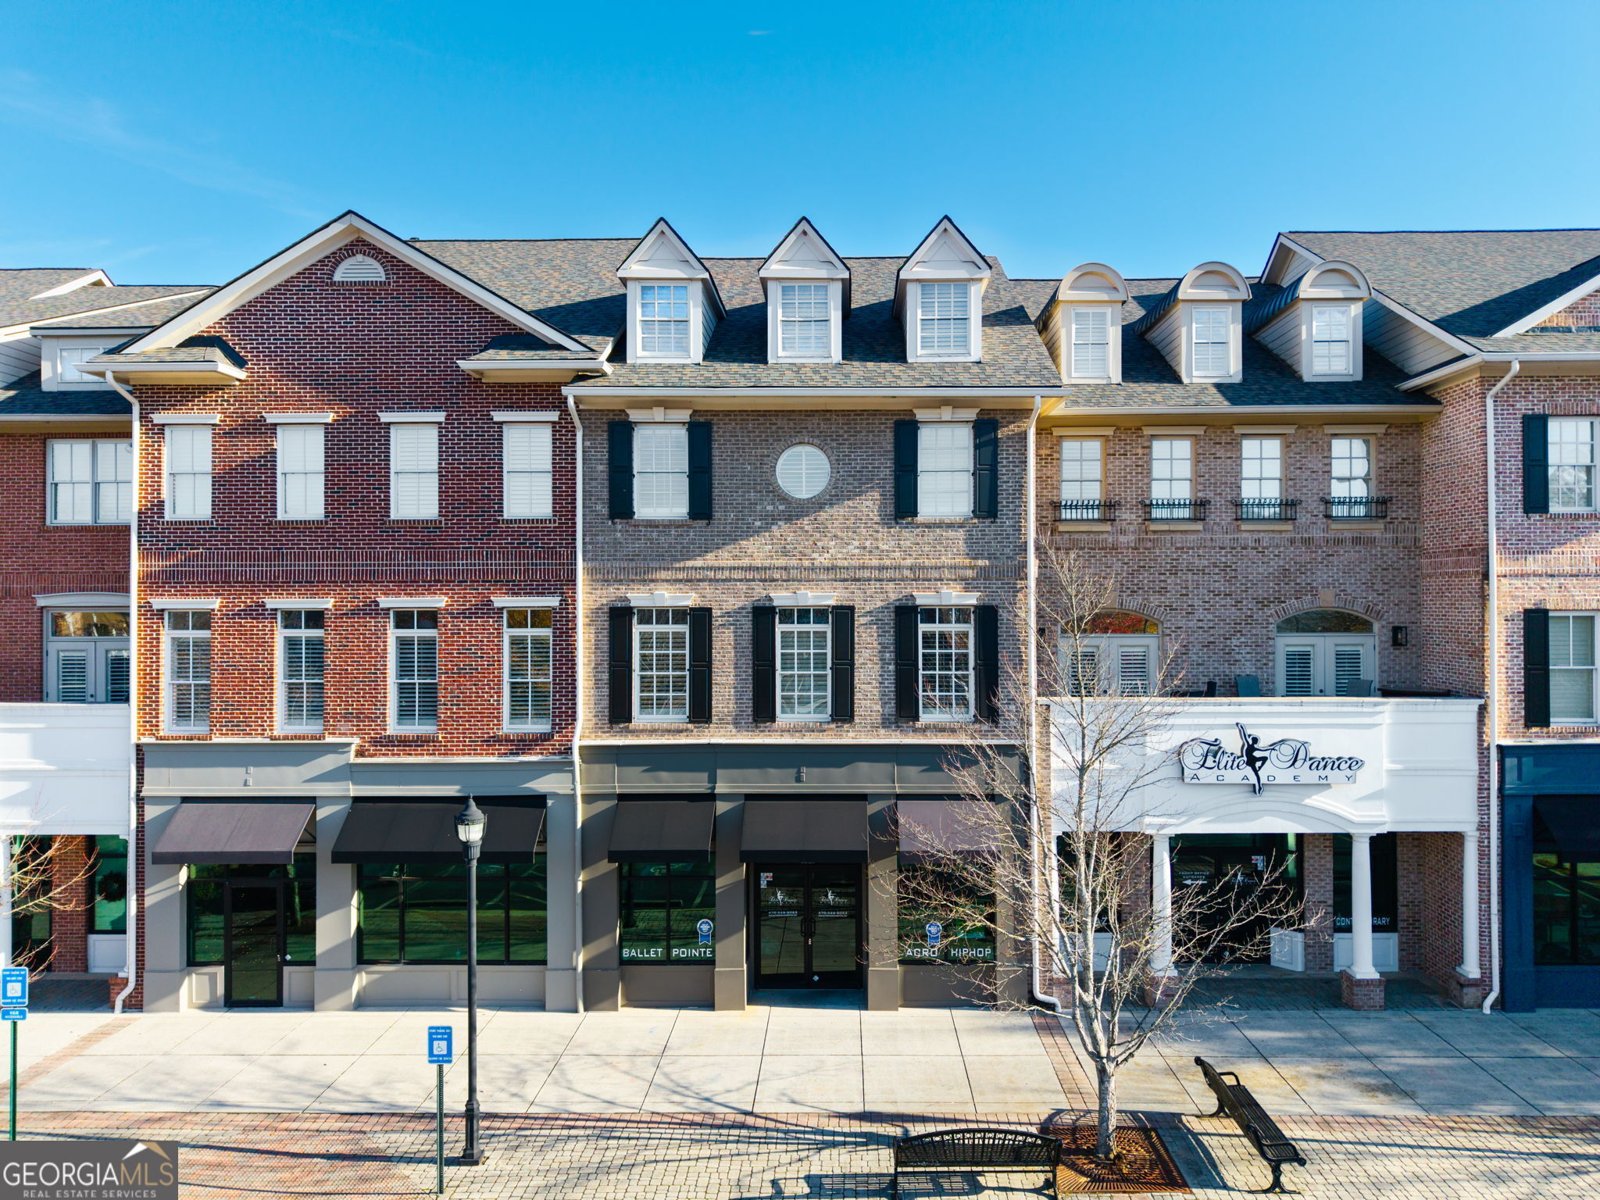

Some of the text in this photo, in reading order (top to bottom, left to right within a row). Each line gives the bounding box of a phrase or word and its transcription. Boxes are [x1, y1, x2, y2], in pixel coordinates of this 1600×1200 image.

[1182, 738, 1365, 771] Elite Dance
[1190, 774, 1354, 782] ACADEMY
[622, 948, 713, 957] BALLET POINTE
[951, 948, 992, 957] HIPHOP
